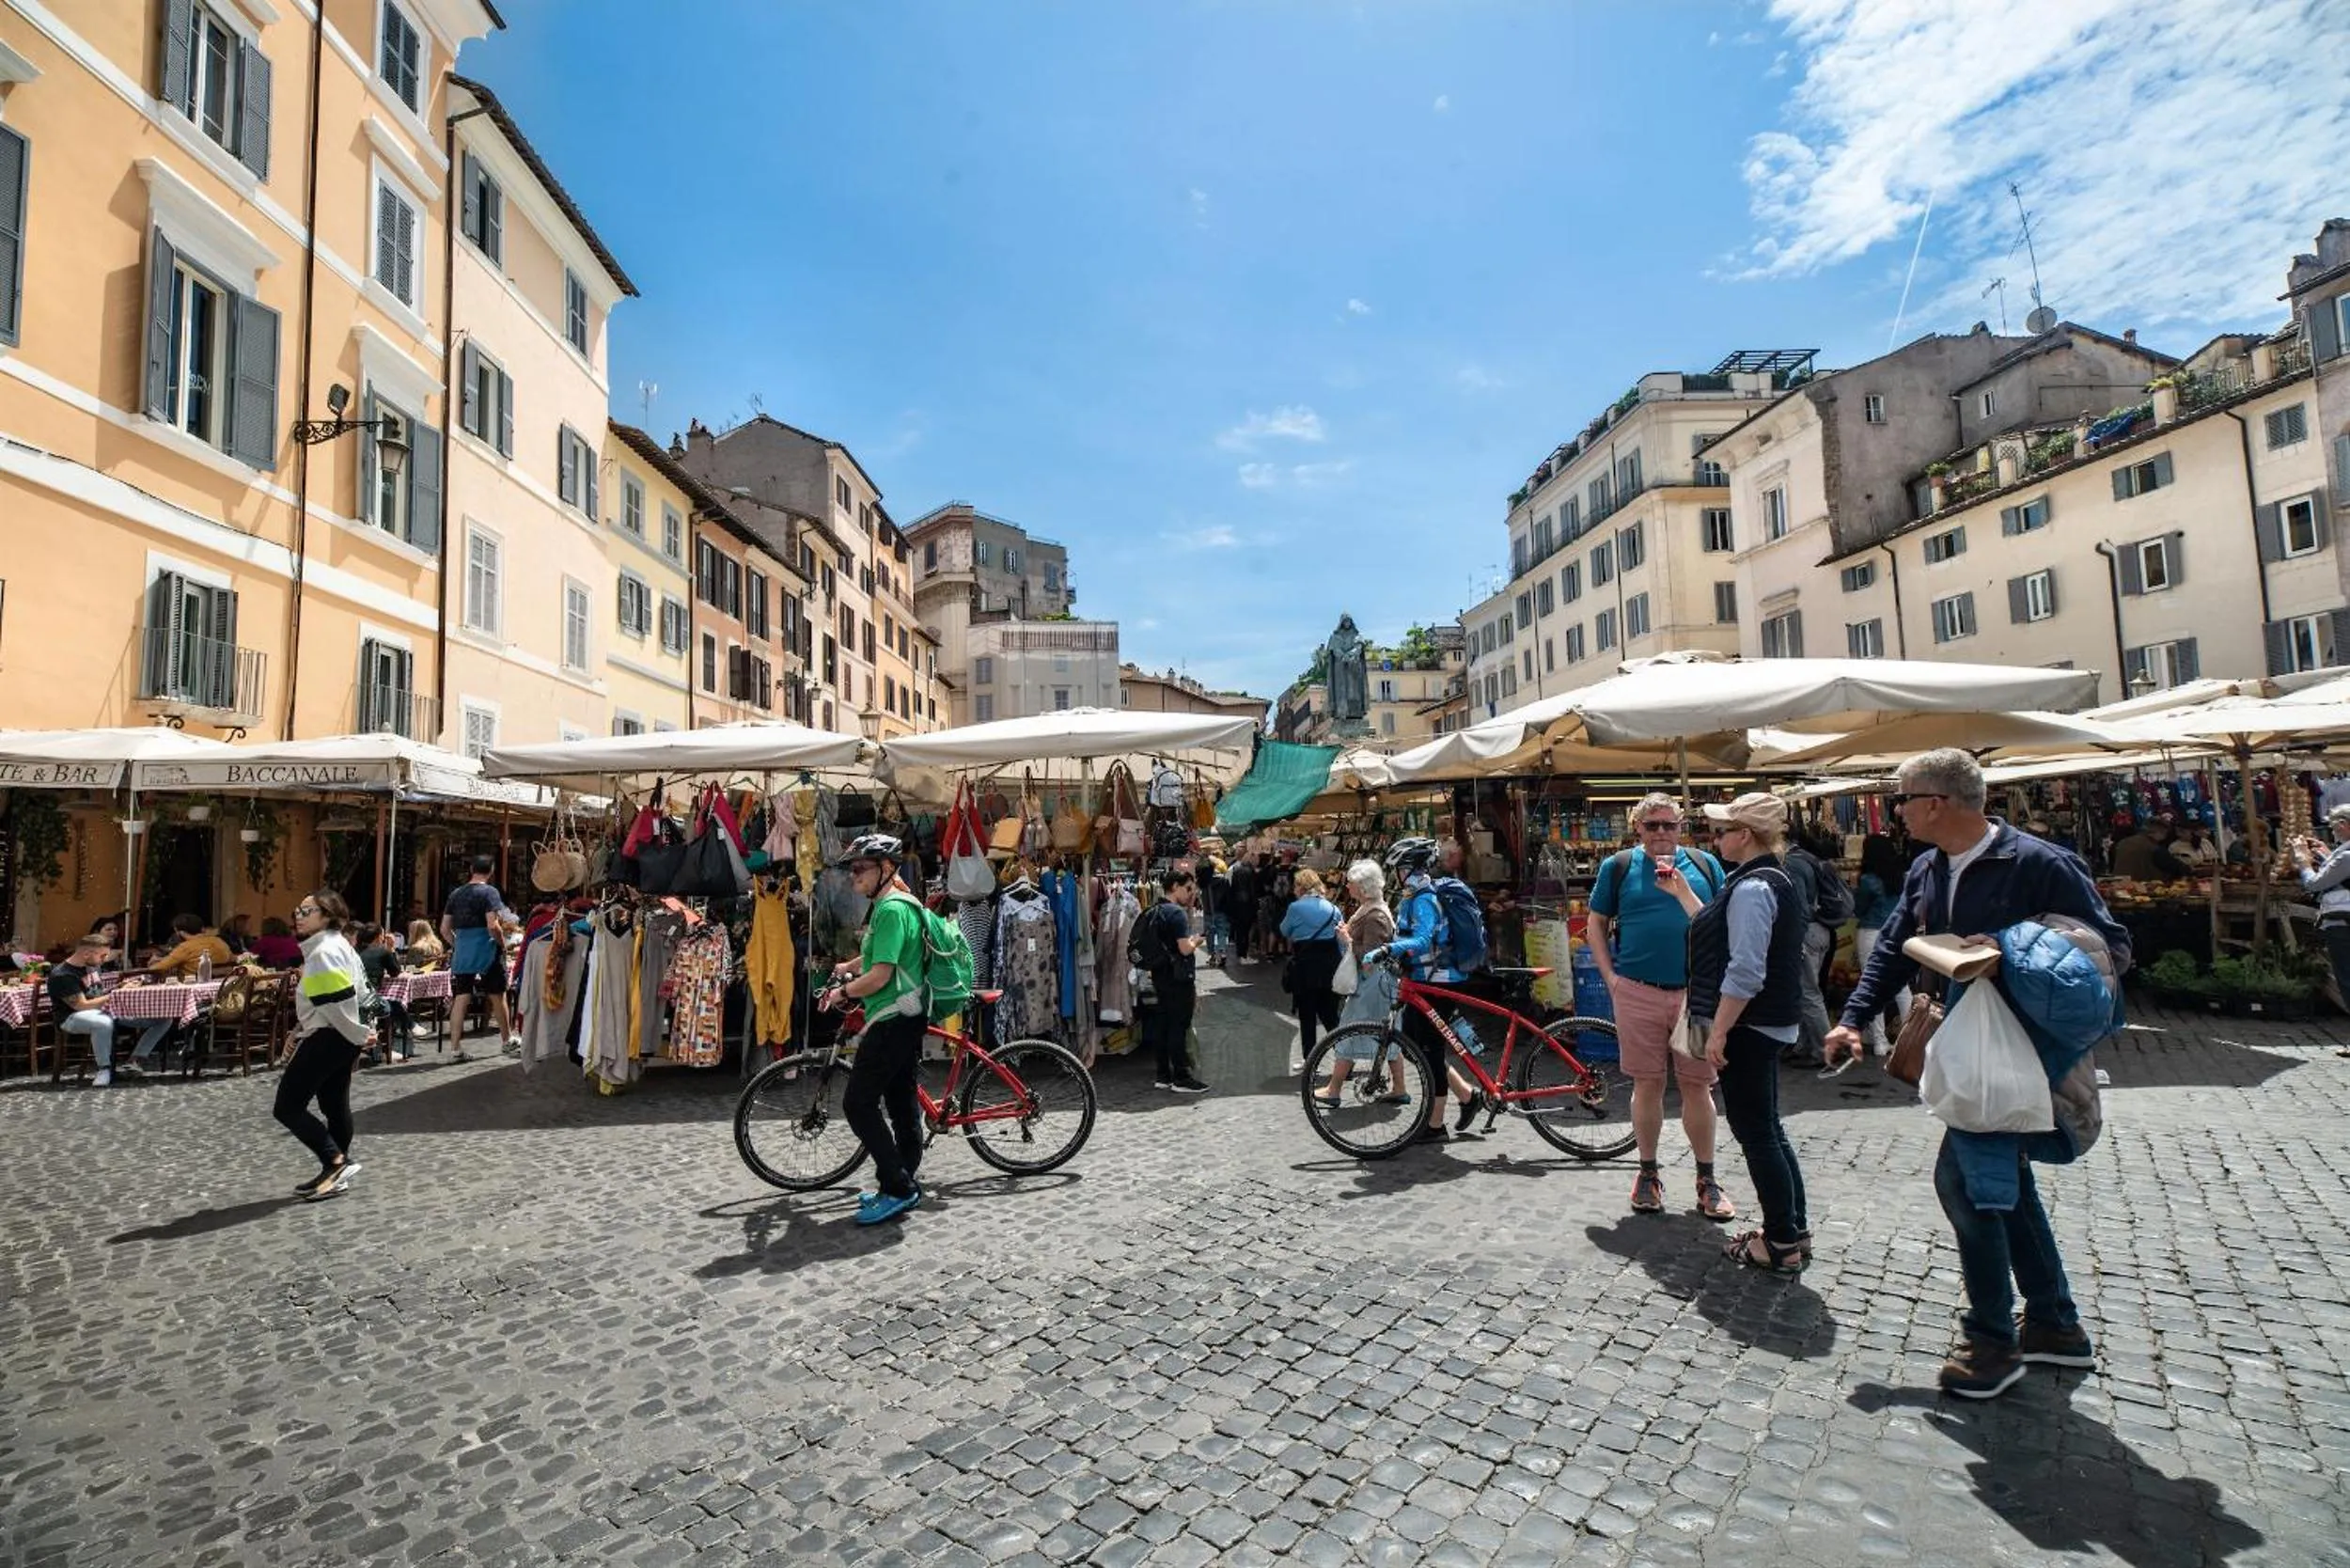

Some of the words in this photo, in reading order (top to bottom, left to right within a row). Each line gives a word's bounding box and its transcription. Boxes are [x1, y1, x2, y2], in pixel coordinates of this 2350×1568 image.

[34, 767, 45, 781] &
[54, 763, 98, 782] BAR
[226, 765, 359, 783] BACCANALE
